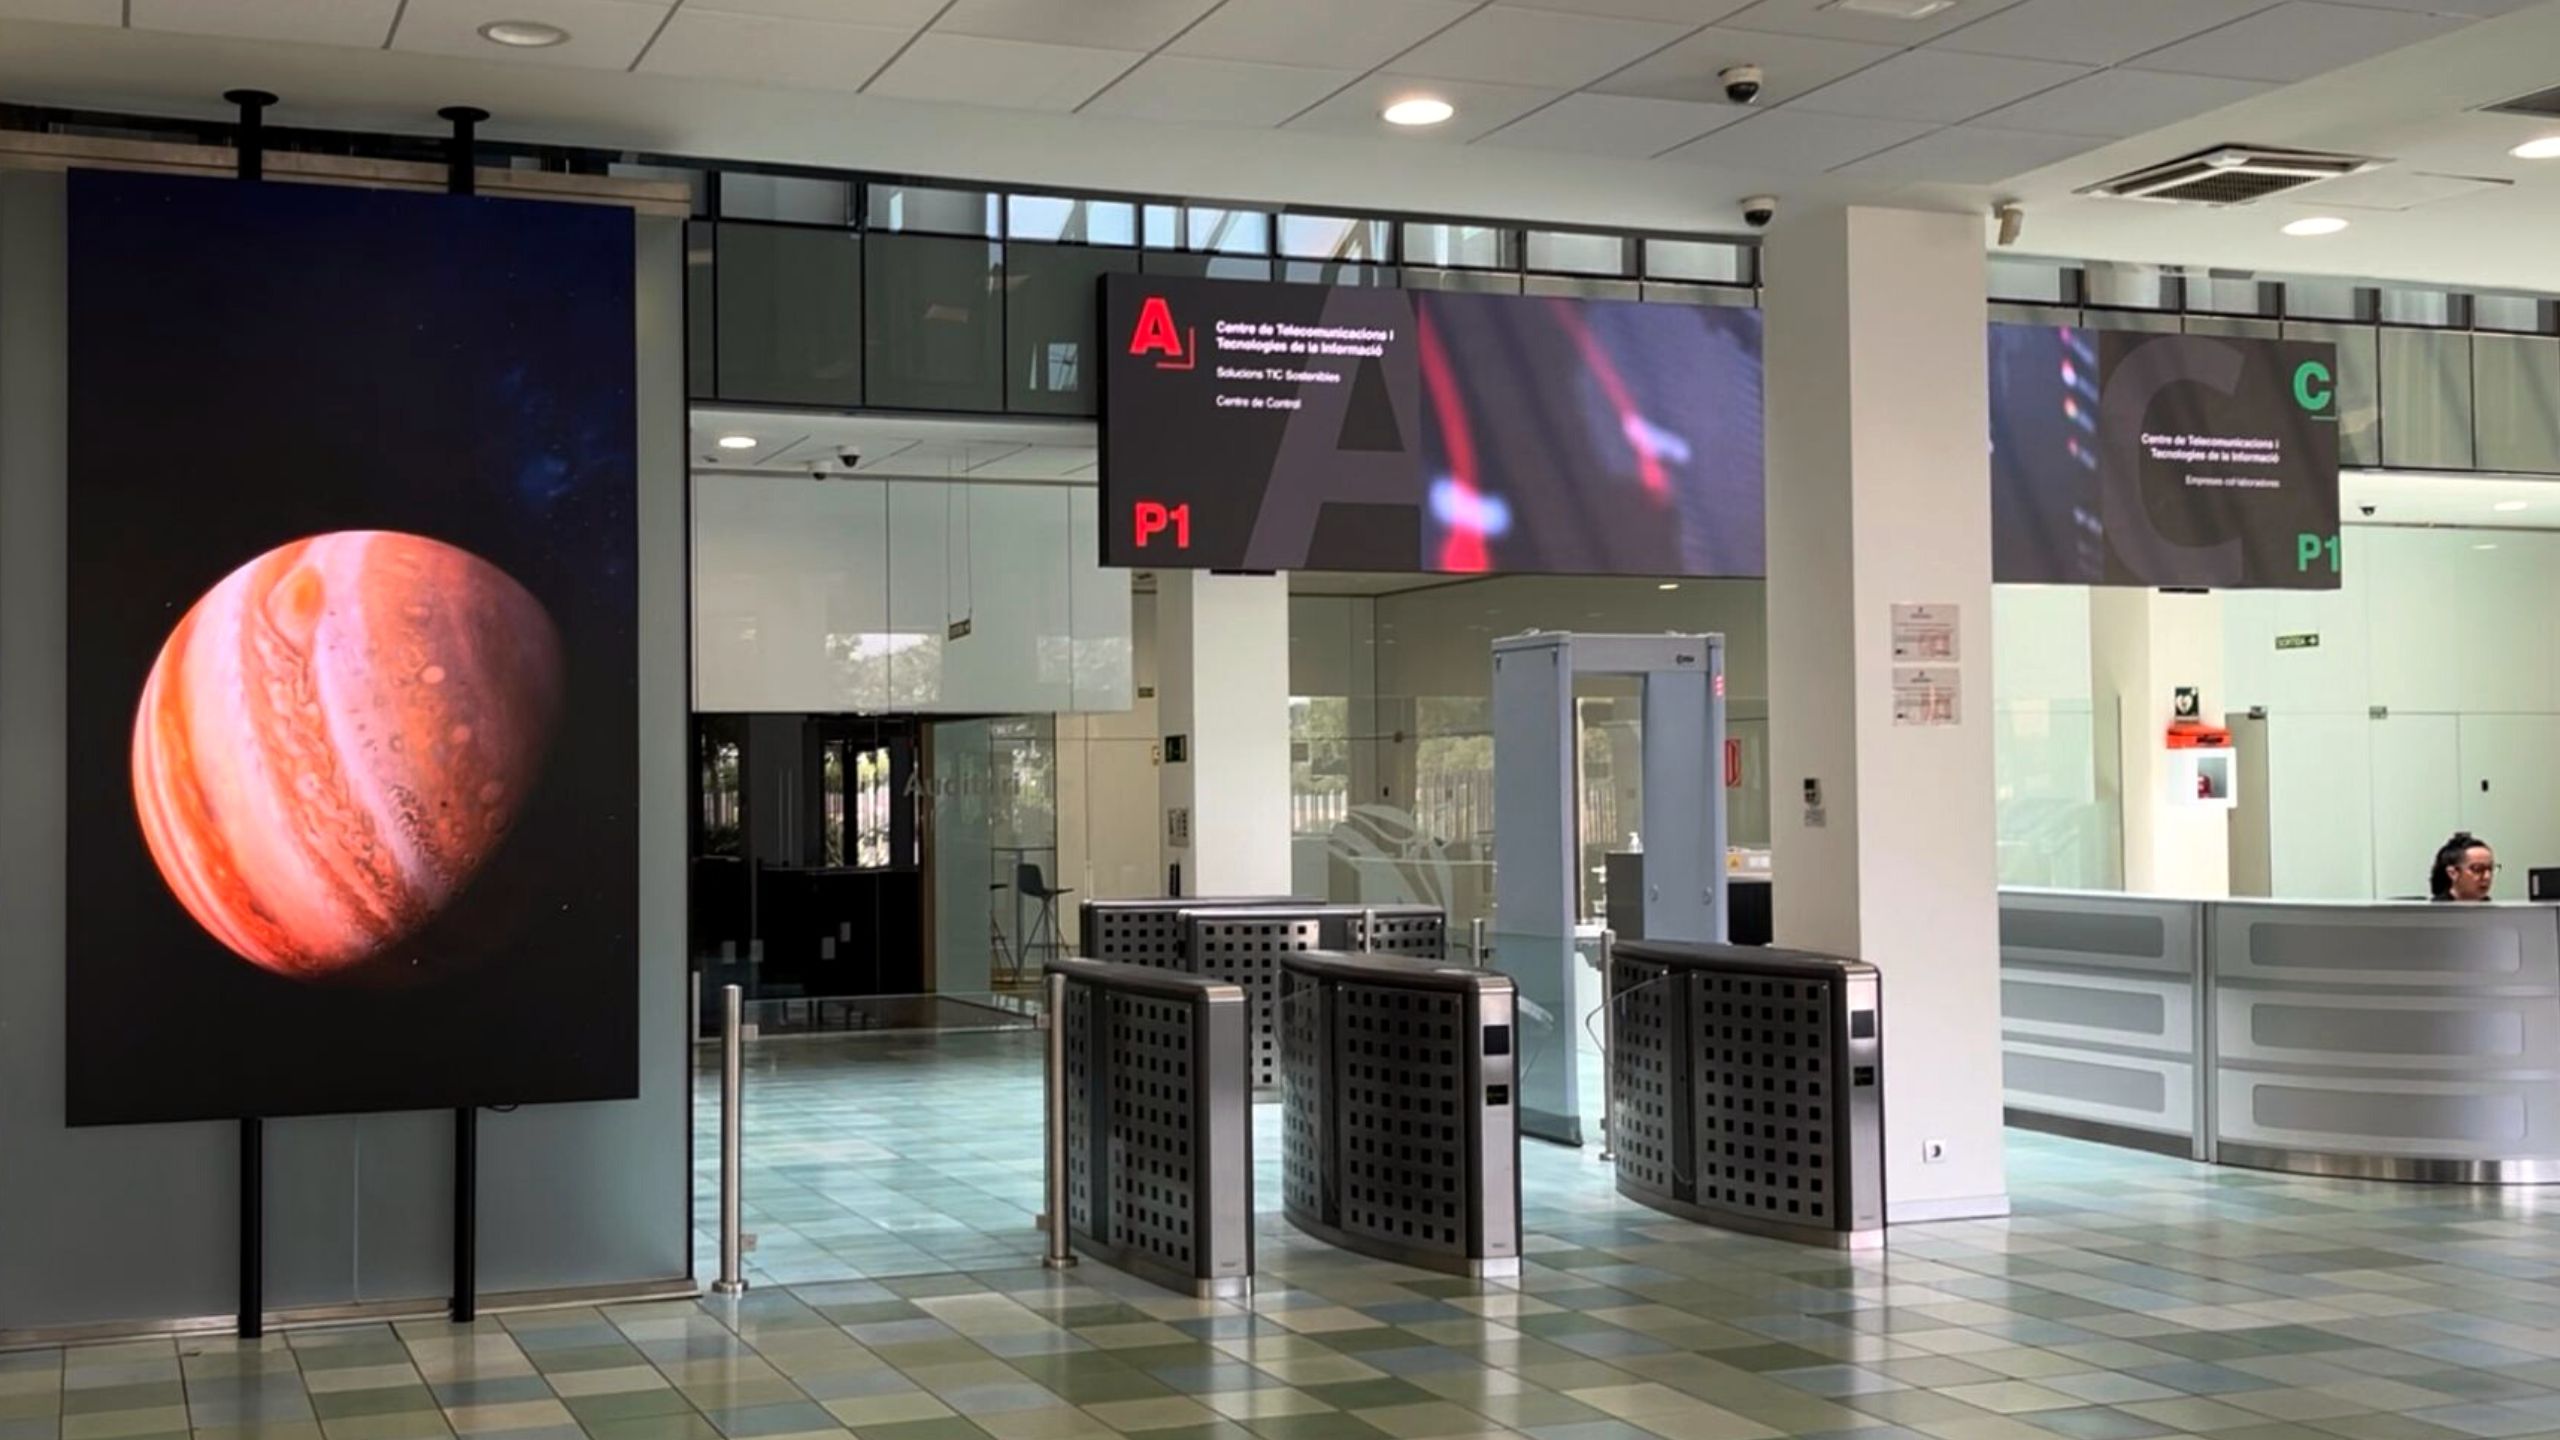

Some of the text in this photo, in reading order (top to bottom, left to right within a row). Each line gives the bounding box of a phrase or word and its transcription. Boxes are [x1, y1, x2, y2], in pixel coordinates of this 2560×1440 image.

[1129, 297, 1183, 355] A
[1216, 320, 1256, 335] Centre
[1258, 322, 1274, 336] de
[1276, 323, 1388, 341] Telecomunicacions
[1216, 336, 1384, 357] Tecnologies de la Informació
[1216, 366, 1341, 383] Solucions TIC Sostenibles
[2293, 361, 2331, 411] C
[1216, 395, 1301, 410] Centre de Control
[2141, 433, 2172, 446] Centre
[2174, 435, 2186, 447] de
[2188, 434, 2273, 449] Telecomunicacions
[2151, 447, 2280, 464] Tecnologies de la Informació
[1134, 501, 1190, 549] P1
[2298, 533, 2340, 574] P1
